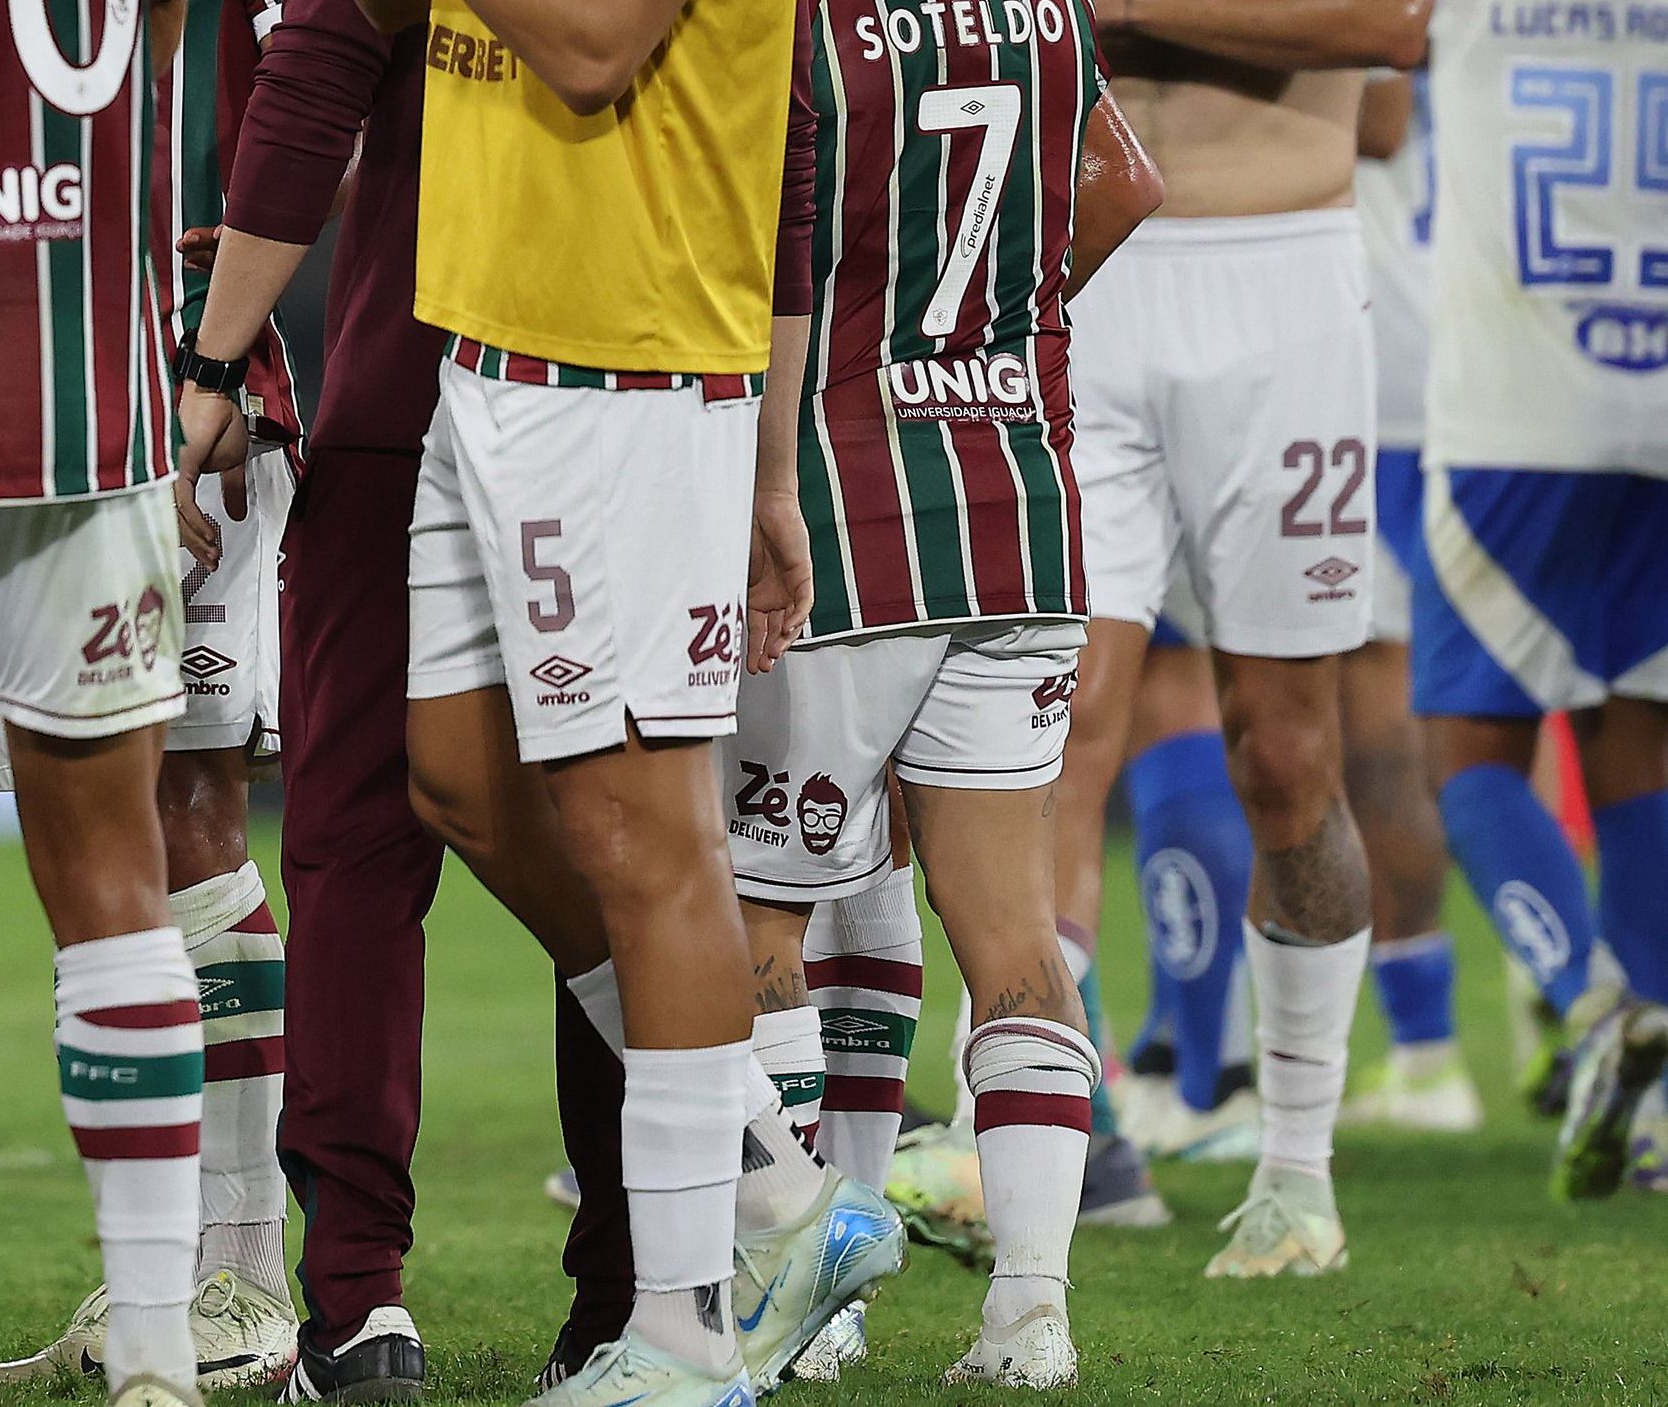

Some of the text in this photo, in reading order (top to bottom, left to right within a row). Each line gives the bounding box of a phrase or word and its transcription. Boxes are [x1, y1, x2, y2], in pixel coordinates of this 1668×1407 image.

[917, 85, 1022, 337] 7
[967, 174, 996, 249] predialnet
[890, 358, 1028, 404] UNIG
[897, 407, 986, 419] UNIVERSIDADE
[1282, 439, 1366, 536] 22
[520, 519, 576, 633] 5
[688, 603, 732, 666] Zé
[185, 680, 230, 696] mbro
[536, 691, 591, 706] umbro
[735, 760, 792, 827] Zé
[729, 819, 790, 848] DELIVERY
[70, 1060, 138, 1084] FFC
